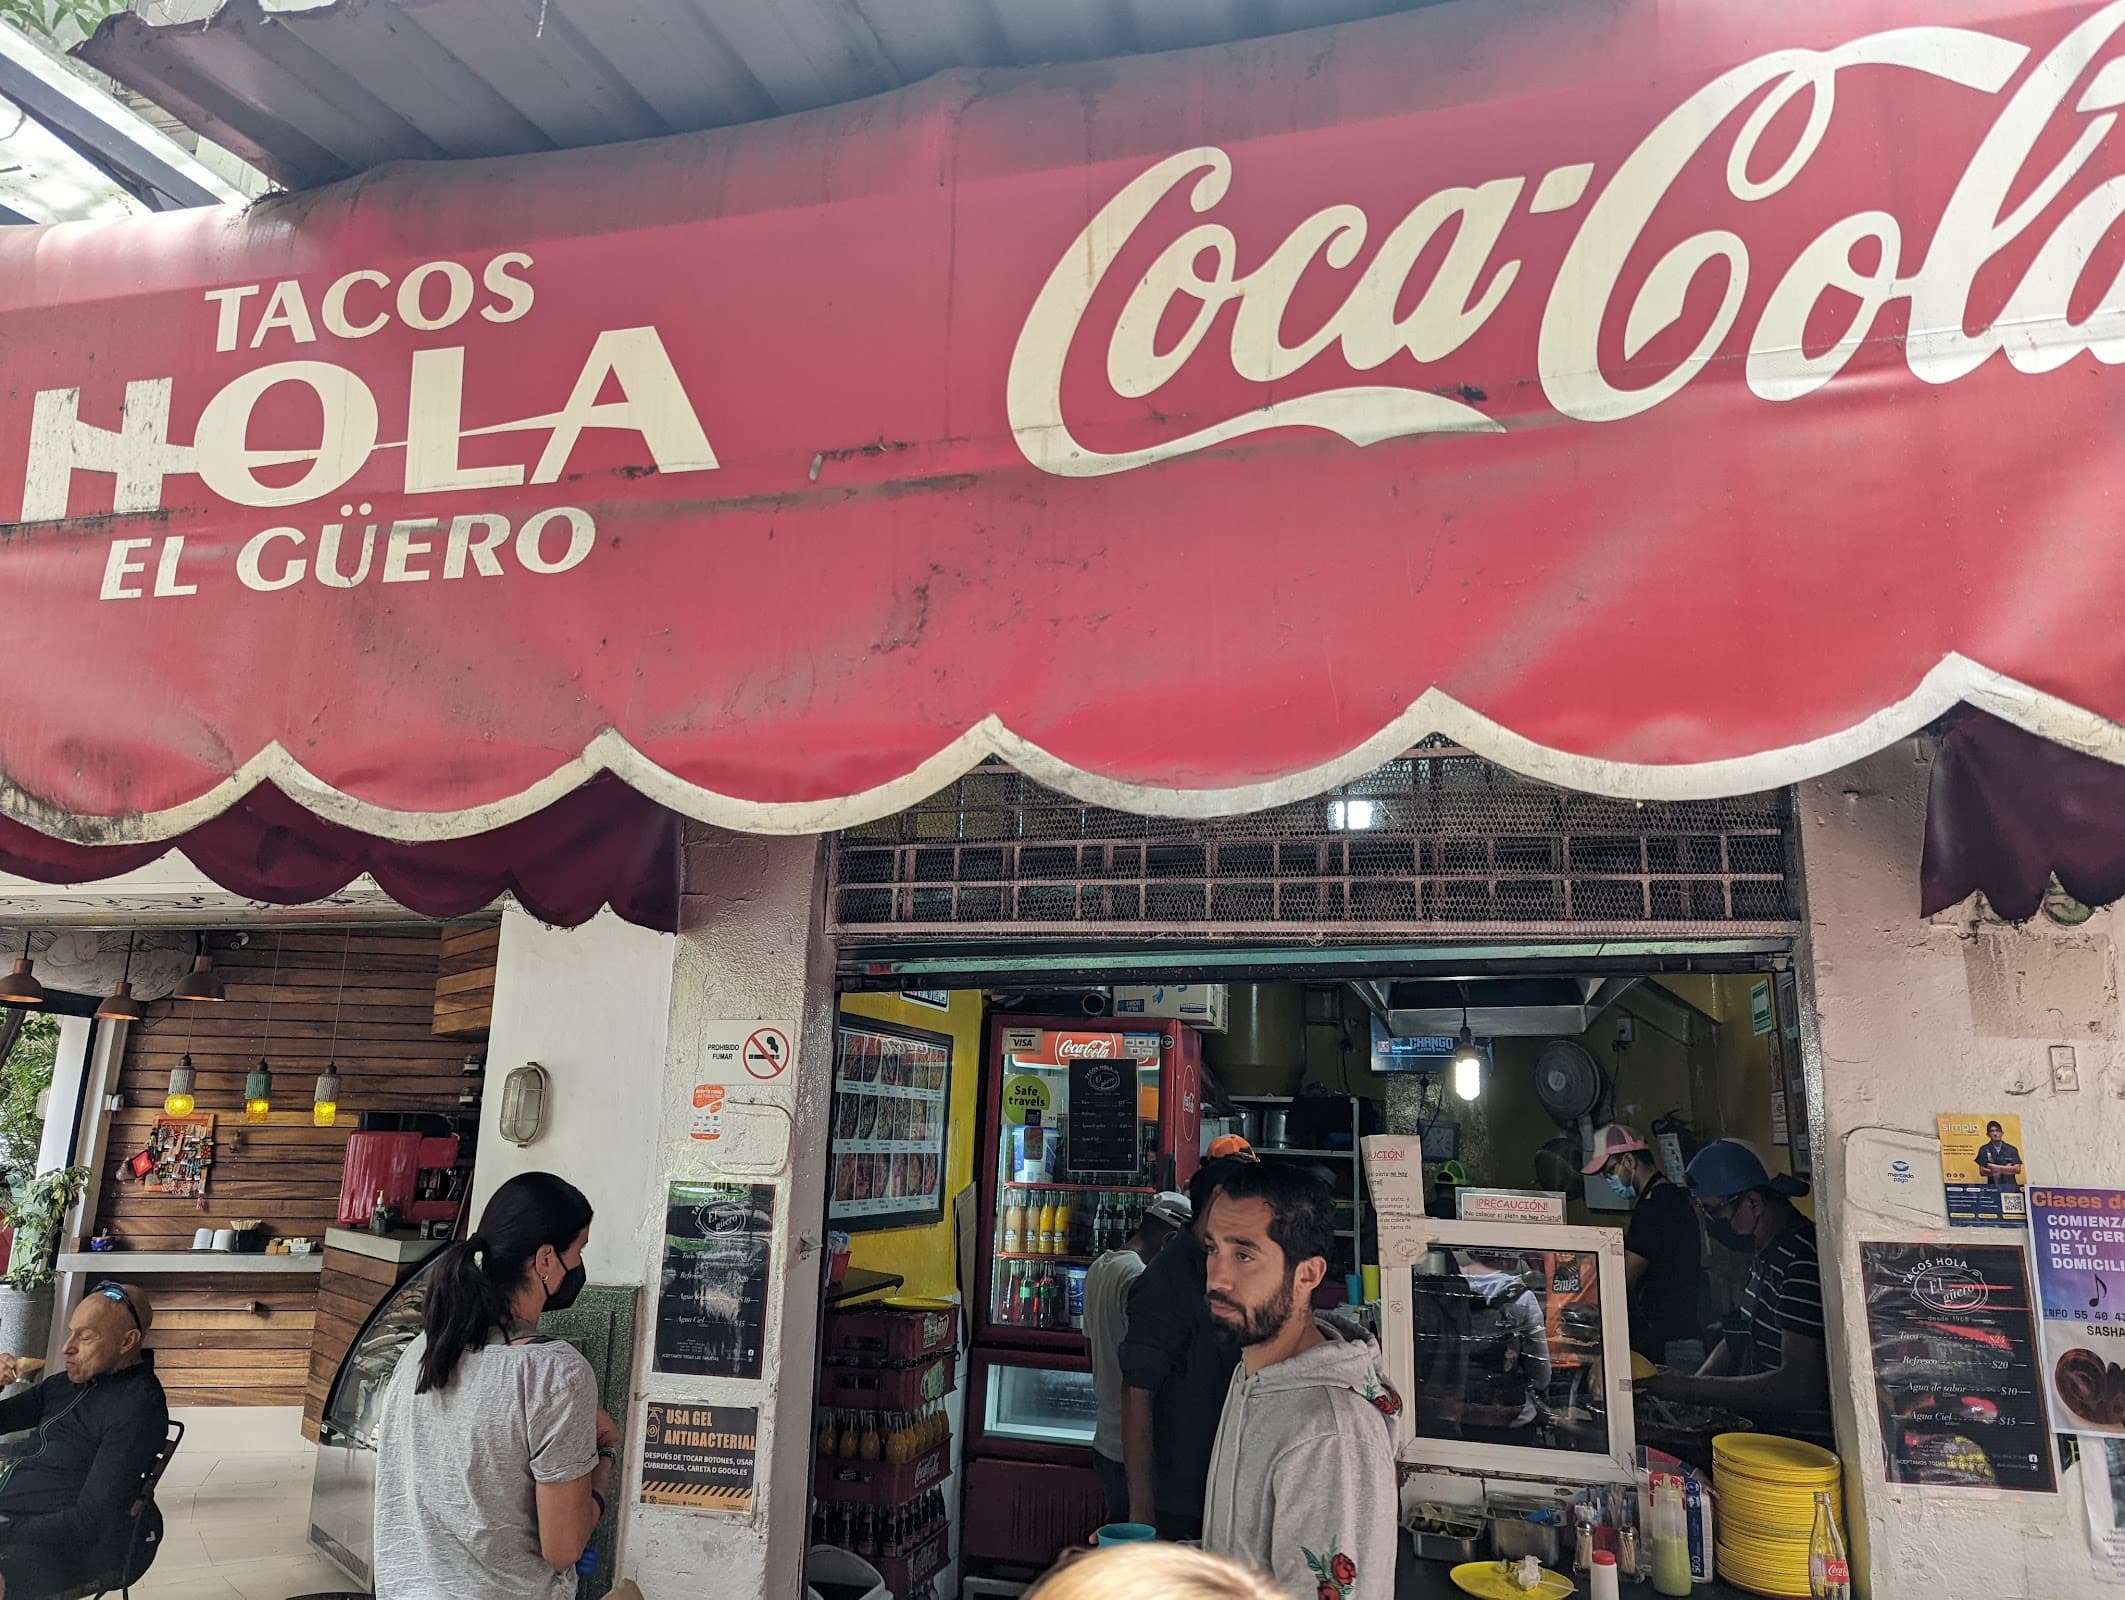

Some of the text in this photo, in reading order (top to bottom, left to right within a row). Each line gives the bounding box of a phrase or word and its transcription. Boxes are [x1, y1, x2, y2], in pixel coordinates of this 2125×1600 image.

[205, 252, 535, 352] TACOS
[21, 326, 720, 523] HOLA
[236, 503, 597, 592] GÜERO
[100, 536, 198, 601] EL
[707, 1043, 740, 1051] PROHIBIDO
[1012, 1038, 1033, 1047] VISA
[1058, 1039, 1113, 1058] Coca-Cola
[1409, 1037, 1454, 1050] CHANGO
[1014, 1085, 1039, 1096] Safe
[1008, 1095, 1046, 1107] travels
[691, 1193, 737, 1216] TACOS HOLA
[2031, 1191, 2103, 1209] Clases
[708, 1209, 718, 1224] El
[2048, 1228, 2088, 1243] HOY,
[2050, 1243, 2097, 1256] DE TU
[1903, 1257, 1969, 1285] TACOS HOLA
[1929, 1277, 1943, 1295] El
[1943, 1284, 1975, 1306] güero
[2043, 1308, 2068, 1318] INFO
[2074, 1309, 2088, 1320] 55
[2094, 1311, 2108, 1321] 40
[1898, 1331, 1919, 1340] Taco
[2086, 1325, 2125, 1338] SASHA
[1902, 1355, 1938, 1367] Refresco
[1907, 1382, 1930, 1393] Agua
[1931, 1383, 1942, 1392] de
[1943, 1384, 1967, 1393] sabor
[666, 1408, 713, 1427] USA GEL
[1911, 1411, 1933, 1422] Agua
[1935, 1412, 1953, 1422] Ciel
[664, 1429, 757, 1451] ANTIBACTERIAL
[644, 1452, 754, 1466] DESPUÉS DE TOCAR BOTONES, USAR
[643, 1461, 687, 1472] CUBREBOCAS,
[687, 1464, 711, 1473] CARETA
[717, 1467, 748, 1476] GOOGLES
